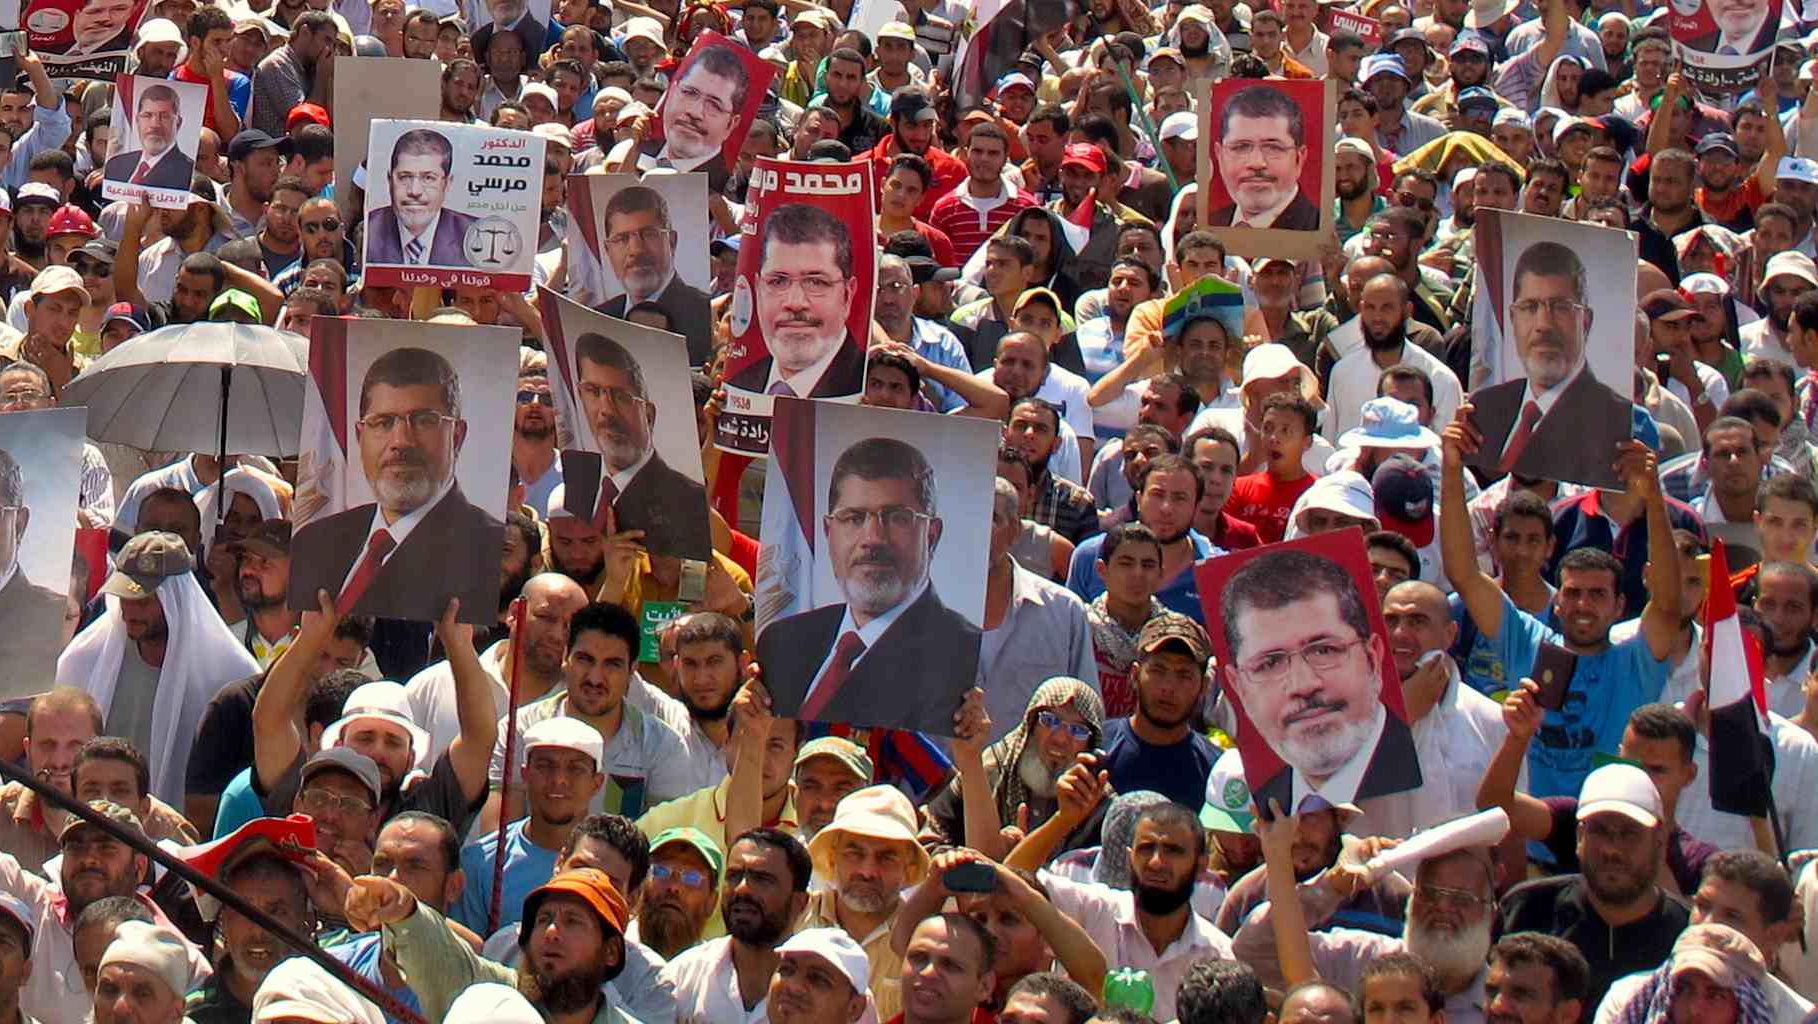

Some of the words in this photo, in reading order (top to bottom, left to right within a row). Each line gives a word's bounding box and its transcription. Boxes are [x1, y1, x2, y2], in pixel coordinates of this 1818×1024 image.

[480, 137, 527, 151] الدكتور
[472, 153, 531, 169] محمد
[467, 177, 528, 198] مرسي
[783, 171, 863, 195] محمد
[739, 419, 770, 444] رادة
